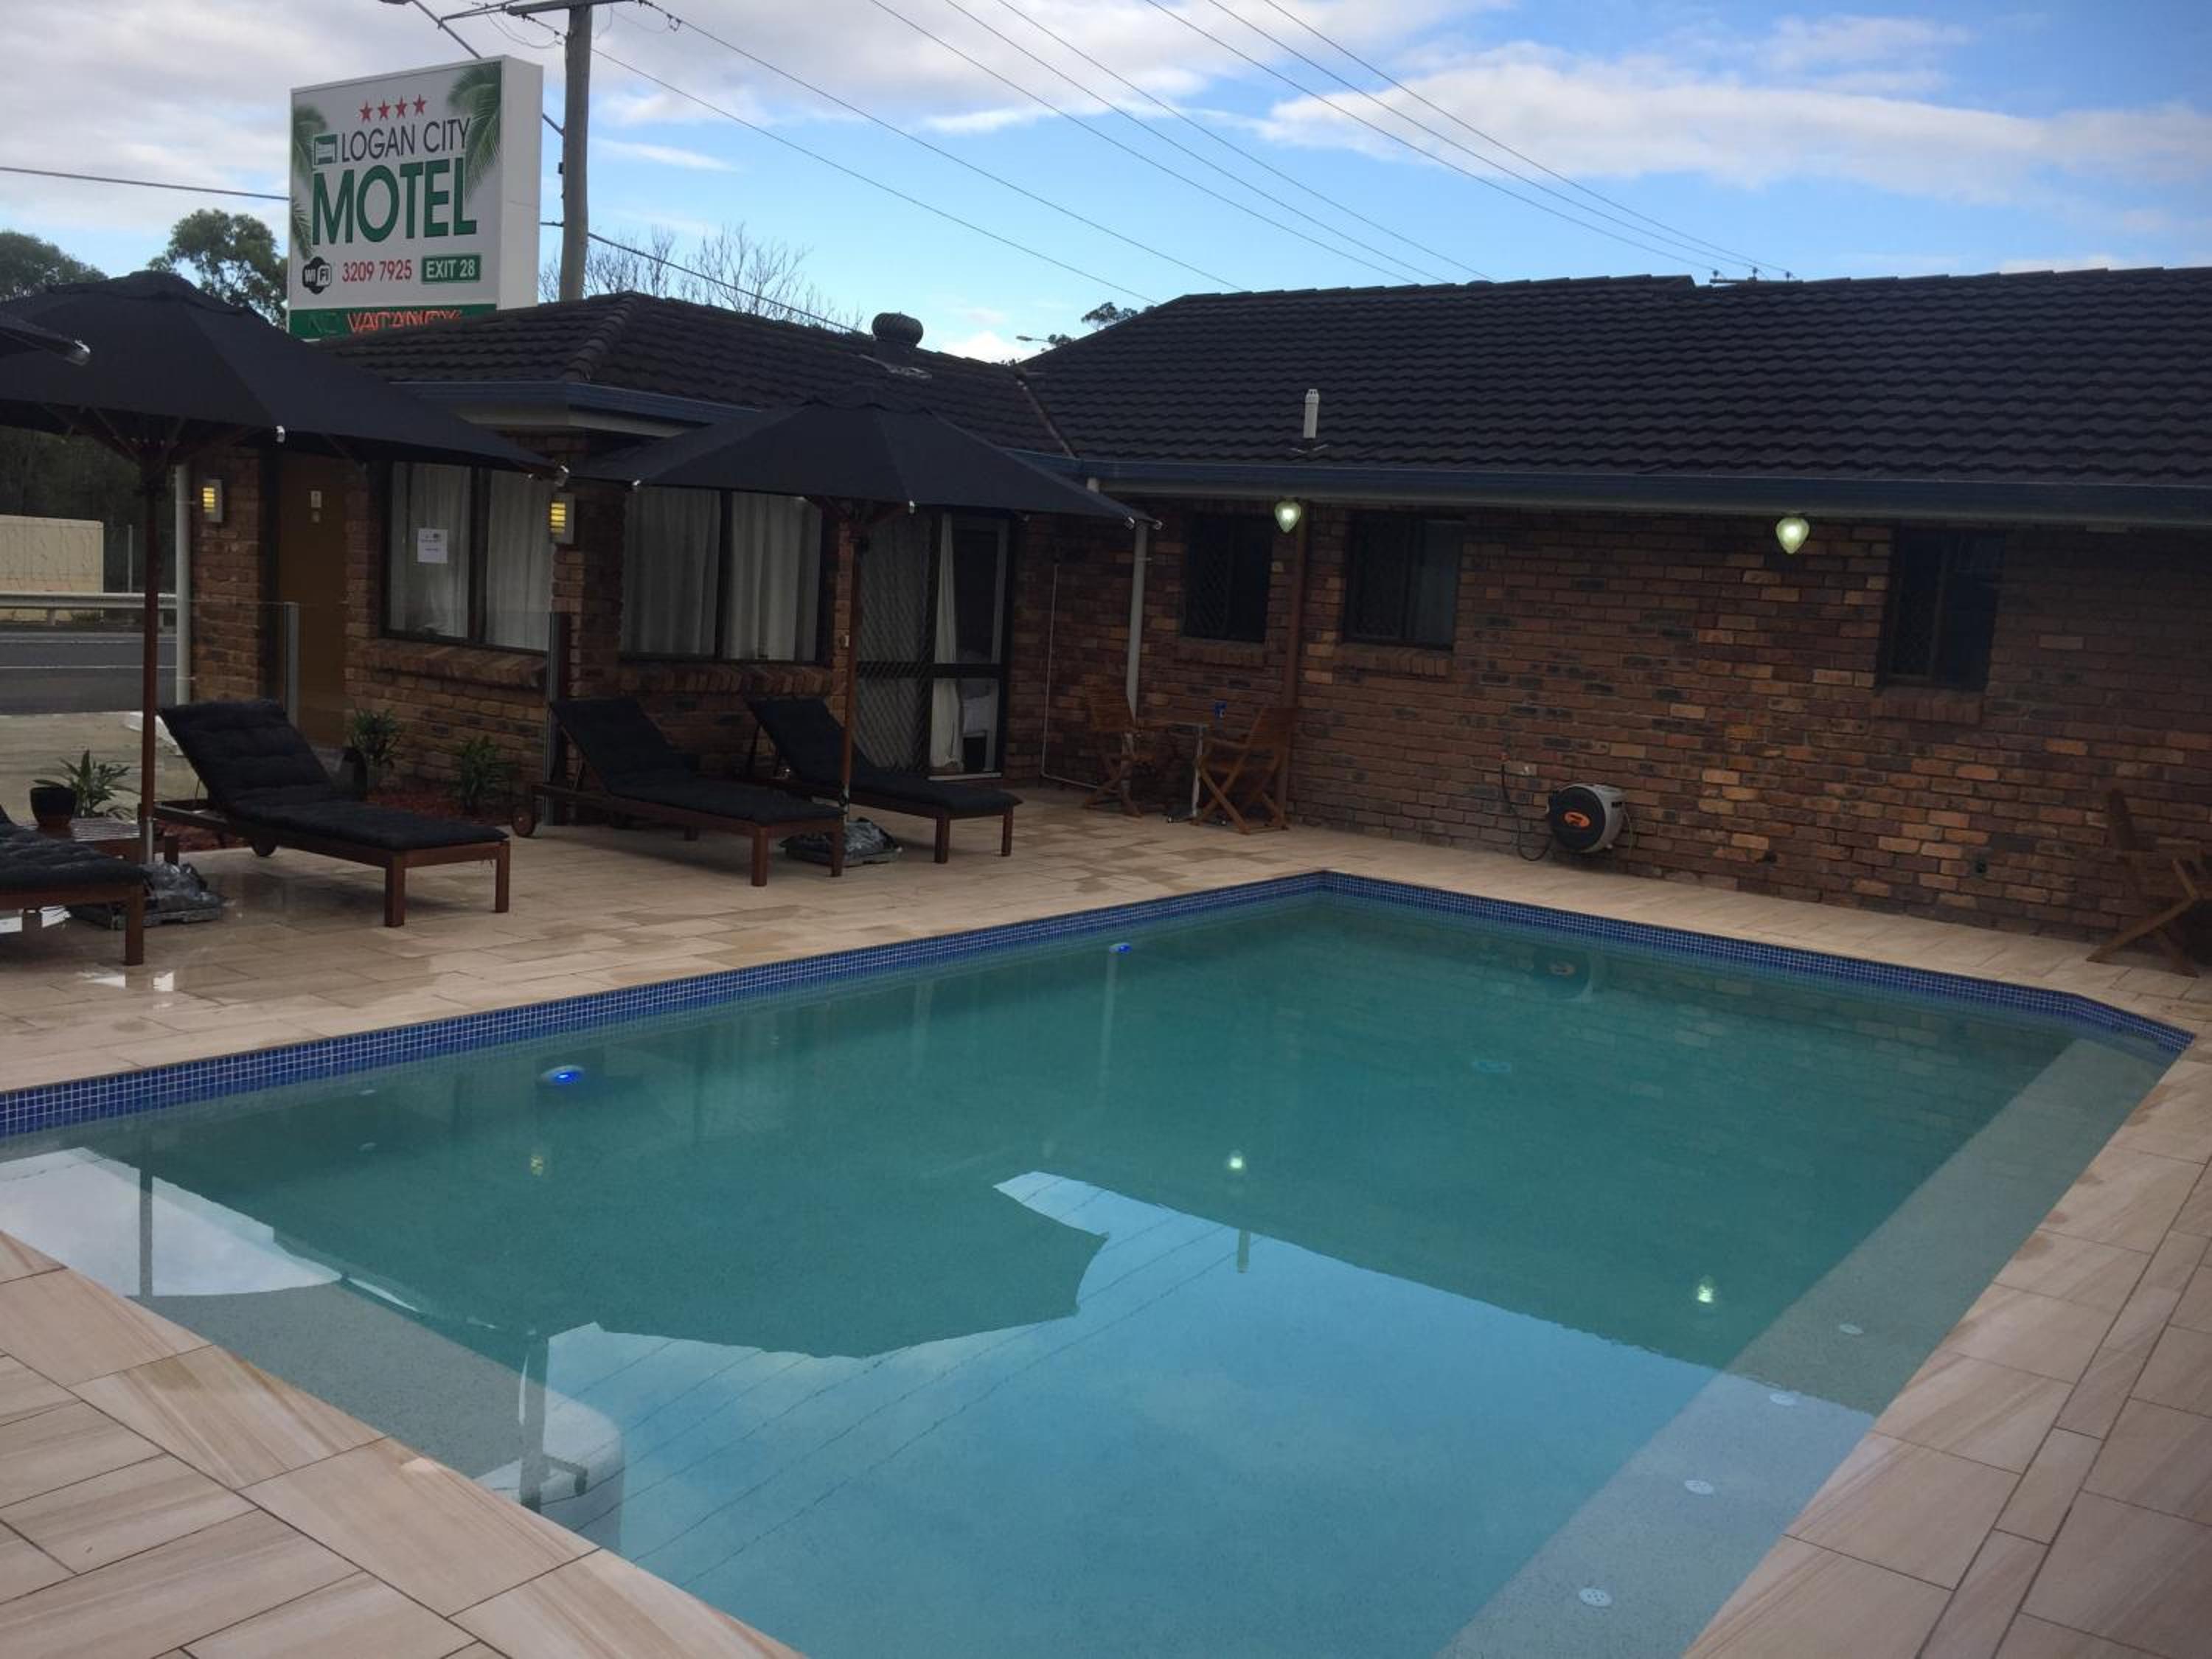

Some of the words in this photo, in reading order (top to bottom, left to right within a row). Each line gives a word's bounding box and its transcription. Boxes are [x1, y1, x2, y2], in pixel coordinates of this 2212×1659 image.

[341, 124, 414, 162] LOGAN
[422, 117, 470, 153] CITY
[312, 157, 477, 246] MOTEL
[342, 262, 375, 282] 3209
[380, 260, 412, 280] 7925
[426, 260, 456, 279] EXIT
[459, 259, 476, 277] 28
